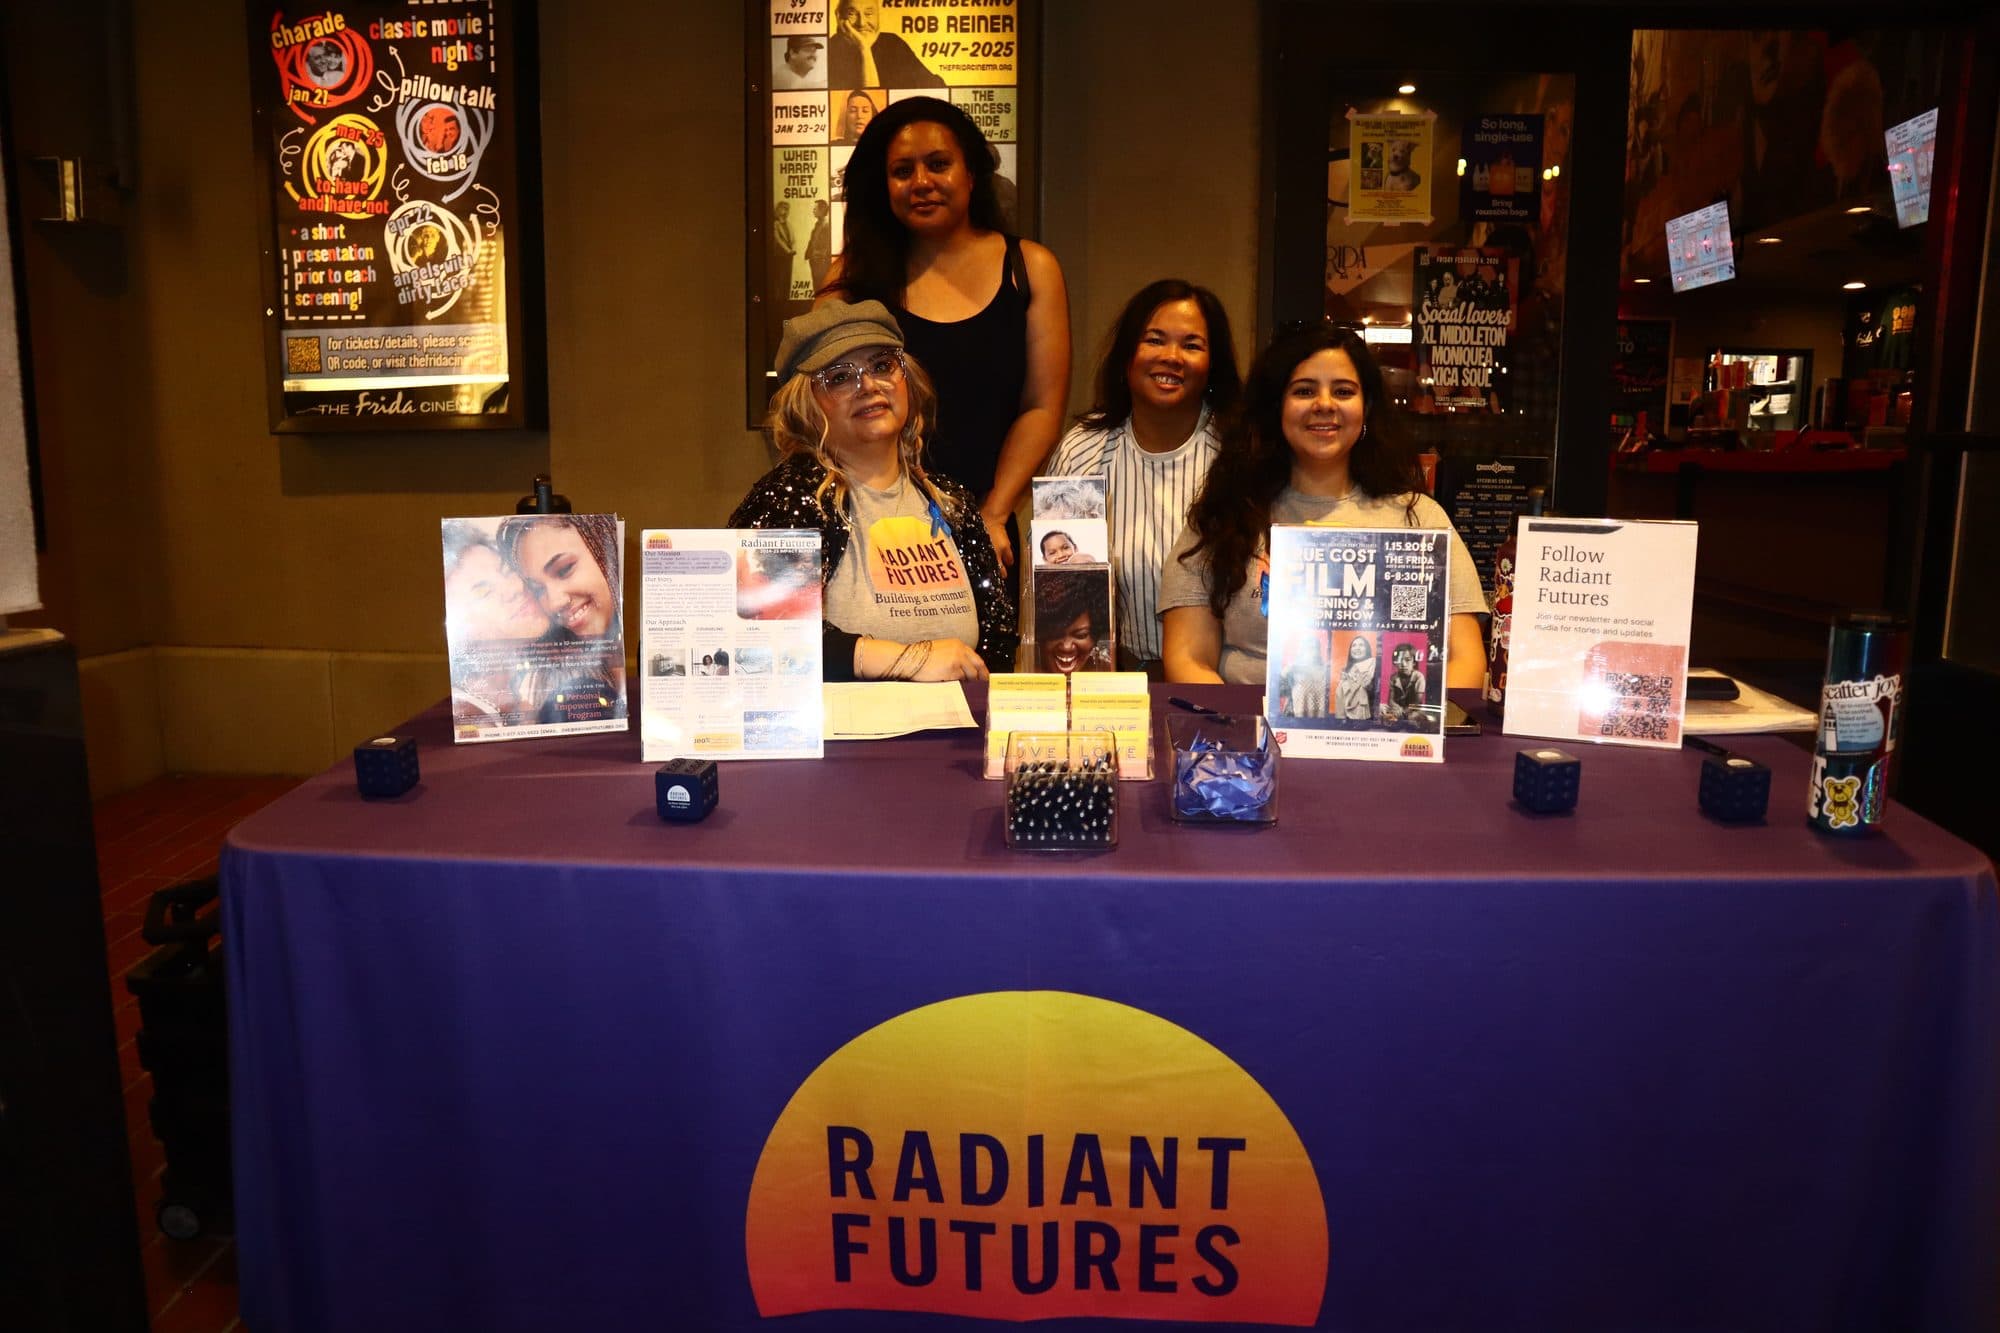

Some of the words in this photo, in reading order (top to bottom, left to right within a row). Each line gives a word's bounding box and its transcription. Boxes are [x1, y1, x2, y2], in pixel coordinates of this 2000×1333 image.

[774, 12, 824, 24] TICKETS
[902, 15, 939, 33] ROB
[946, 15, 1015, 33] REINER
[272, 12, 345, 49] charade
[369, 17, 427, 40] classic
[432, 16, 482, 37] movie
[431, 40, 483, 71] nights
[921, 41, 1015, 57] 1947-2025
[287, 86, 309, 105] jan
[311, 89, 329, 105] 21
[400, 75, 456, 103] pillow
[458, 84, 497, 110] talk
[972, 90, 994, 101] THE
[775, 104, 826, 119] MISERY
[775, 125, 793, 133] JAN
[797, 123, 826, 133] 23-24
[977, 116, 1000, 127] RIDE
[1481, 118, 1497, 129] So
[336, 124, 361, 141] mar
[366, 129, 384, 148] 25
[1474, 131, 1534, 144] single-use
[427, 157, 448, 174] feb
[451, 154, 467, 171] 18
[783, 150, 817, 161] WHEN
[780, 163, 817, 174] HARRY
[316, 177, 330, 194] to
[335, 177, 369, 195] have
[788, 175, 814, 186] MET
[784, 187, 818, 198] SALLY
[299, 196, 325, 212] and
[329, 196, 361, 213] have
[364, 198, 390, 214] not
[388, 214, 410, 237] apr
[414, 203, 433, 224] 22
[300, 226, 309, 240] a
[312, 223, 345, 240] short
[293, 246, 374, 269] presentation
[294, 268, 325, 290] prior
[327, 268, 341, 284] to
[344, 267, 376, 283] each
[393, 262, 440, 289] angels
[444, 254, 474, 273] with
[398, 283, 432, 304] dirty
[793, 281, 810, 289] JAN
[295, 287, 362, 311] screening!
[1417, 301, 1466, 325] Social
[328, 337, 342, 350] for
[345, 335, 421, 349] tickets/details,
[423, 335, 455, 351] please
[1421, 325, 1437, 344] XL
[1440, 325, 1507, 346] MIDDLETON
[328, 356, 340, 371] QR
[343, 355, 370, 370] code,
[372, 356, 383, 368] or
[385, 355, 406, 368] visit
[1432, 346, 1493, 367] MONIQUEA
[1432, 366, 1459, 387] XICA
[1462, 367, 1492, 387] SOUL
[318, 404, 350, 415] THE
[355, 391, 416, 416] Frida
[741, 538, 778, 548] Radiant
[1384, 541, 1434, 552] 1.15.2026
[1329, 547, 1377, 563] COST
[1384, 555, 1404, 564] THE
[1406, 555, 1434, 565] FRIDA
[1541, 546, 1605, 564] Follow
[885, 560, 959, 586] FUTURES
[1539, 567, 1612, 586] Radiant
[875, 593, 921, 605] Building
[930, 590, 969, 601] commu
[1364, 598, 1375, 610] &
[1537, 588, 1609, 607] Futures
[890, 607, 911, 617] free
[914, 606, 938, 617] from
[1336, 610, 1374, 620] SHOW
[1569, 614, 1611, 624] newsletter
[1630, 618, 1655, 626] social
[1620, 629, 1653, 638] updates
[1872, 676, 1899, 701] joy
[826, 1125, 1247, 1210] RADIANT
[831, 1212, 1242, 1298] FUTURES
